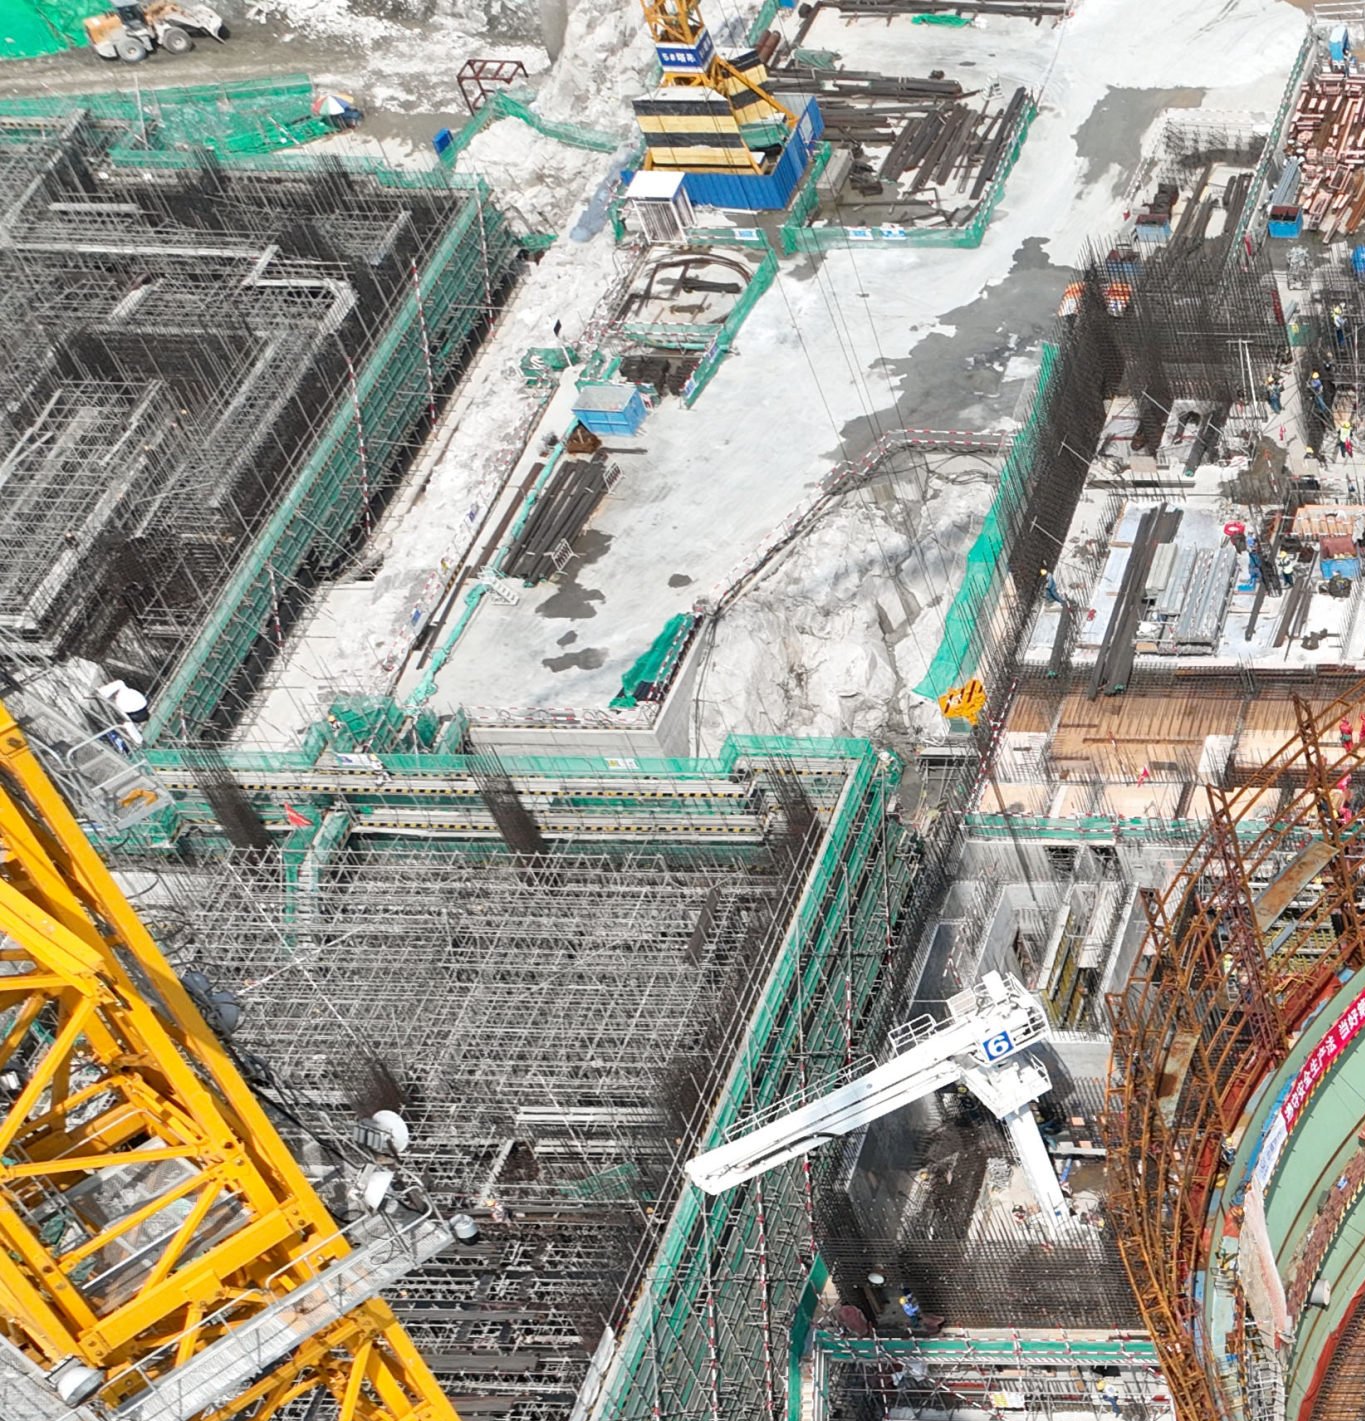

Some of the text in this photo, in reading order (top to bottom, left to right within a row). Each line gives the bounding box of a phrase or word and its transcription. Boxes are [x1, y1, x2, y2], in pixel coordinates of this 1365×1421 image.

[987, 1034, 1009, 1057] 6
[1283, 1037, 1337, 1121] 遵守安全生产法
